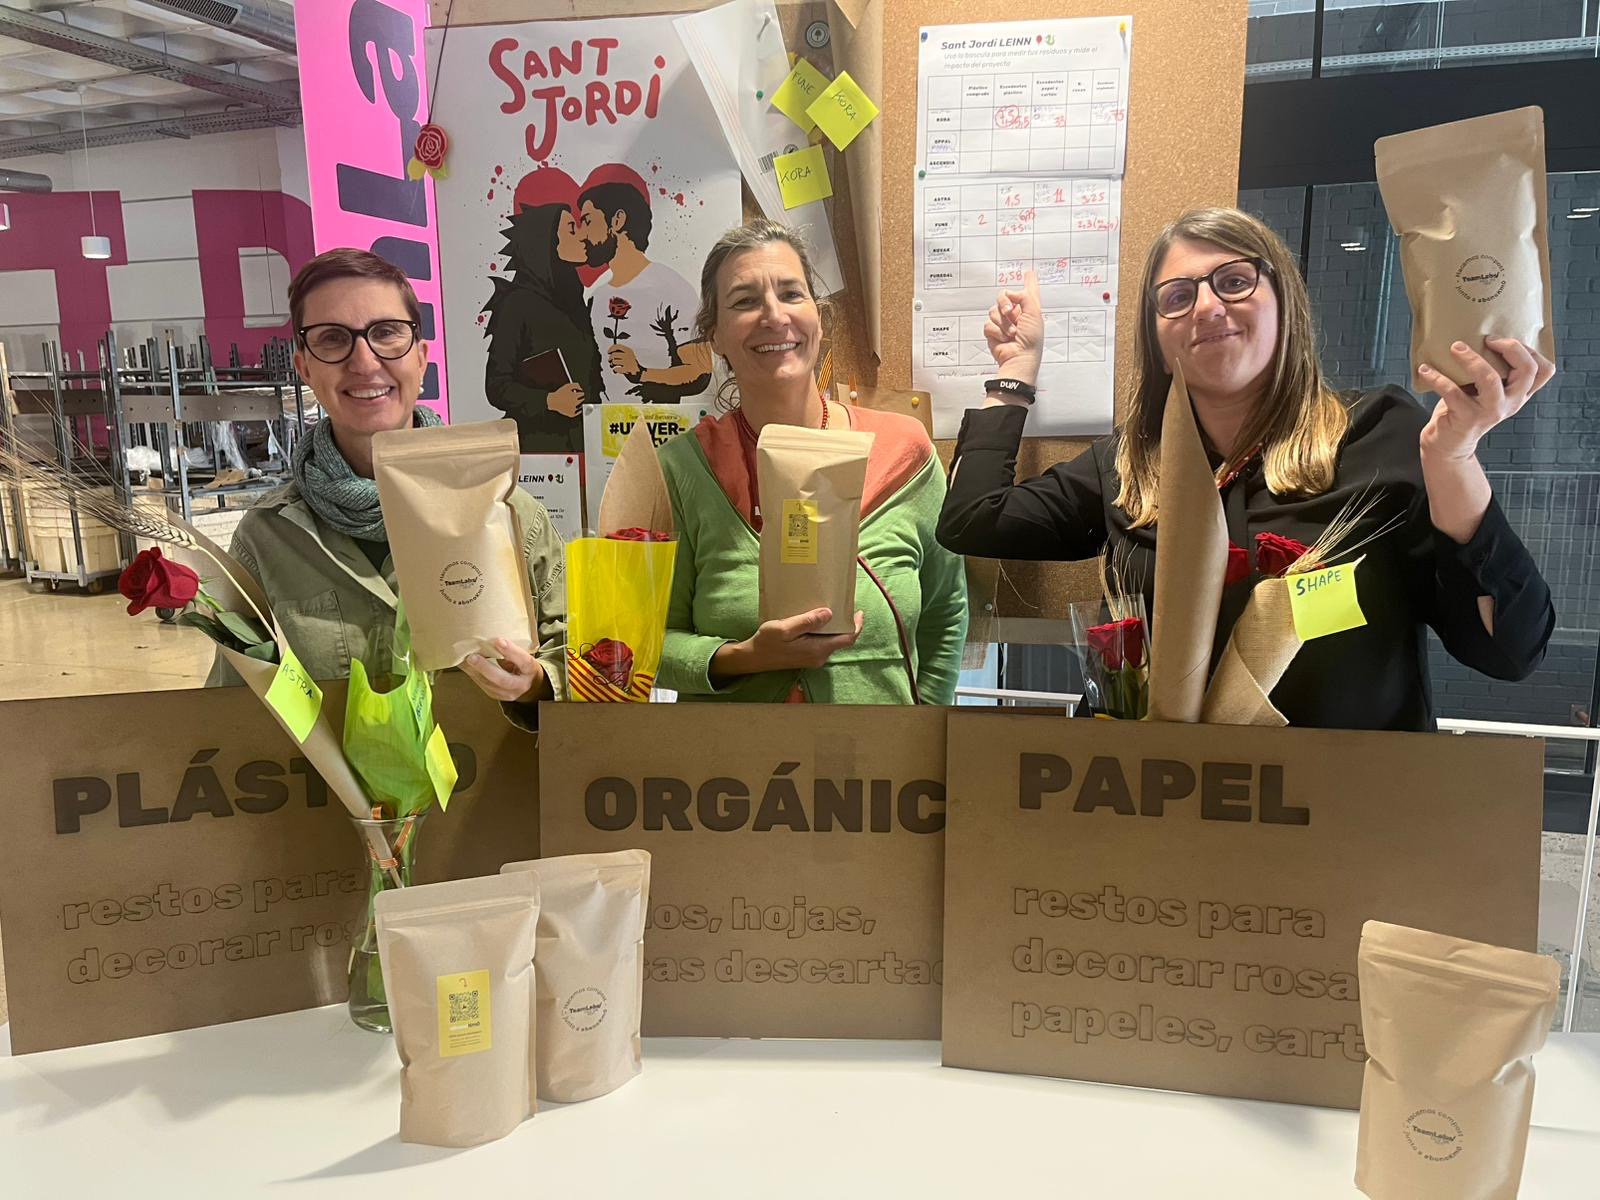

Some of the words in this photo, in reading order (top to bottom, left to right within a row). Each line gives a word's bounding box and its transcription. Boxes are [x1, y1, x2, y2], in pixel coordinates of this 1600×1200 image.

[941, 40, 966, 50] Sant
[969, 38, 997, 49] Jordi
[999, 37, 1032, 47] LEINN
[992, 51, 1007, 59] para
[1008, 49, 1026, 57] medir
[1039, 47, 1067, 55] residuos
[488, 38, 619, 114] SANT
[970, 61, 981, 69] del
[982, 60, 1012, 70] proyecto
[792, 71, 816, 96] FUNE
[831, 89, 856, 121] KORA
[779, 166, 812, 187] KORA
[609, 422, 685, 435] #UVER-
[518, 475, 545, 483] LEINN
[1296, 570, 1342, 596] SHAPE
[281, 663, 314, 700] ASTRA
[1019, 752, 1310, 826] PAPEL
[63, 880, 244, 930] restos
[253, 867, 365, 913] para
[1014, 885, 1188, 927] restos
[1198, 900, 1325, 939] para
[732, 895, 876, 939] hojas,
[66, 930, 281, 984] decorar
[1012, 937, 1224, 988] decorar
[1011, 1001, 1233, 1053] papeles,
